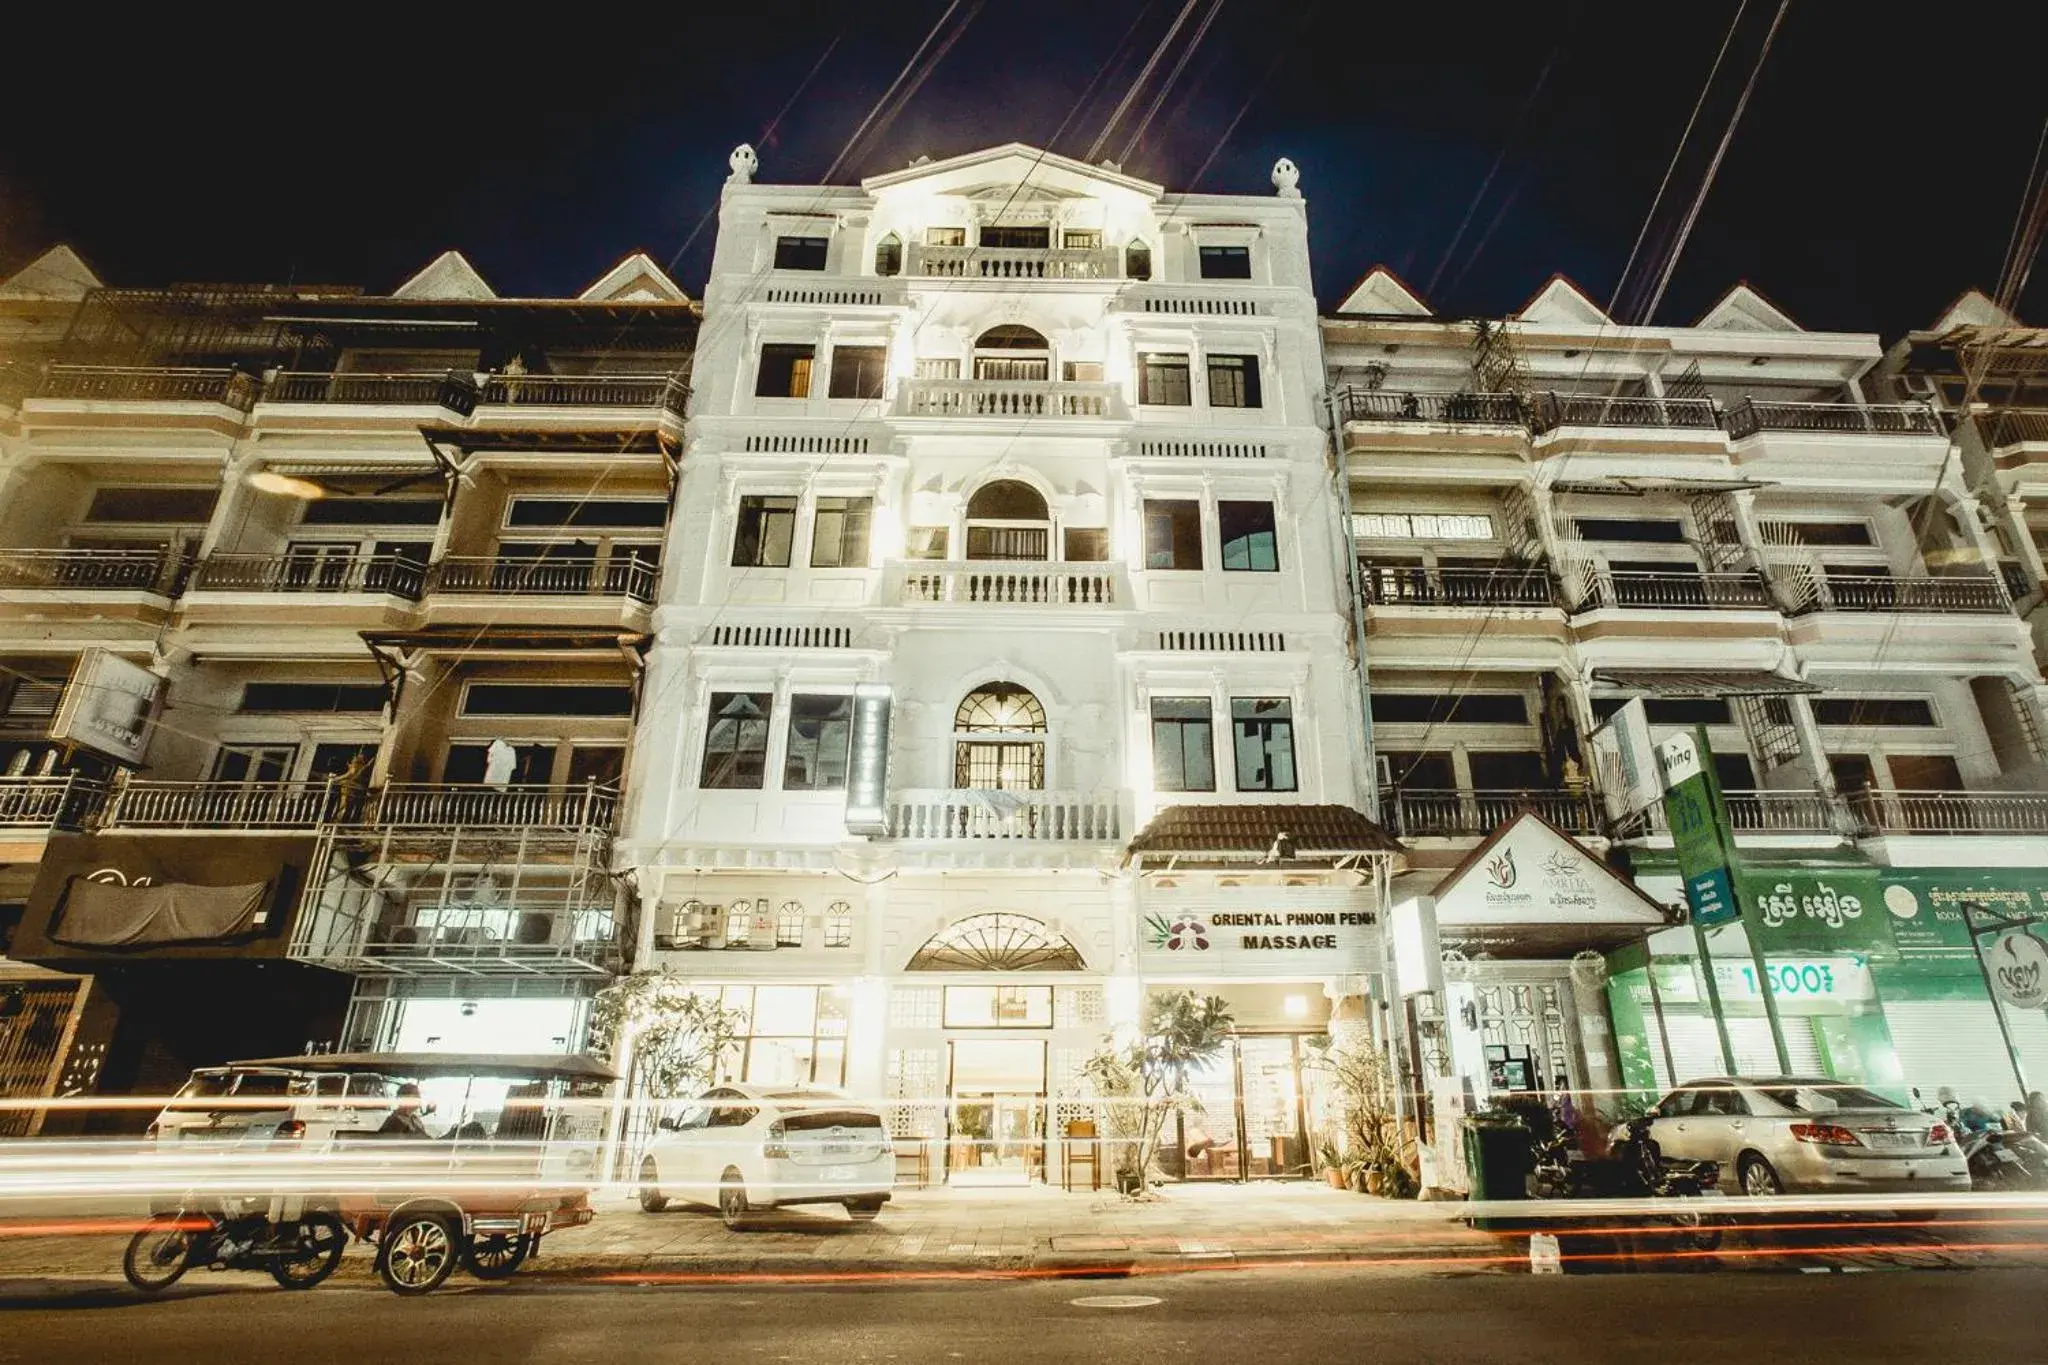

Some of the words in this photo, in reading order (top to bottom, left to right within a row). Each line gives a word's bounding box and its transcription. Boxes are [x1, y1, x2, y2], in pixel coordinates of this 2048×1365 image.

[1663, 749, 1692, 772] Wing
[1212, 913, 1282, 926] ORIENTAL
[1287, 912, 1336, 925] PHNOM
[1340, 911, 1377, 925] PENH
[1243, 935, 1337, 950] MASSAGE
